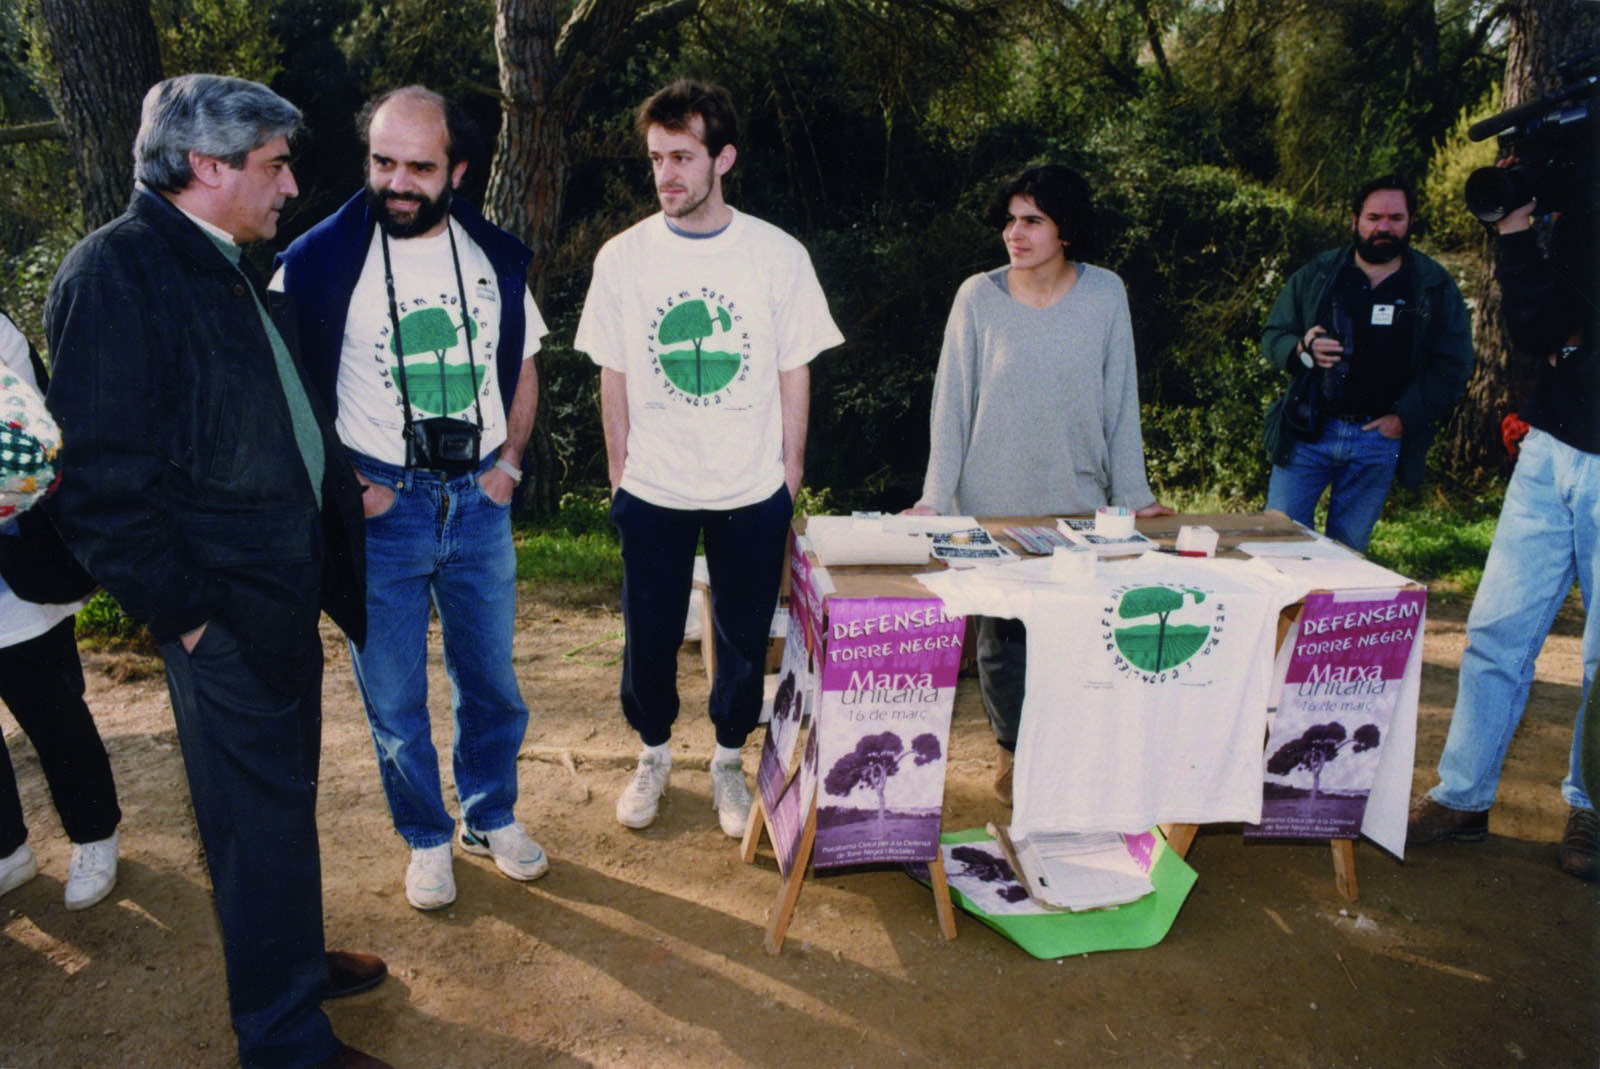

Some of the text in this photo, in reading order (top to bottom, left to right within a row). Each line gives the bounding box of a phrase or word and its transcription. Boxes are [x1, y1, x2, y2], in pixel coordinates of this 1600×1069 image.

[374, 297, 428, 390] DEFENEM
[1303, 601, 1419, 637] DEFENSEM
[829, 633, 962, 663] TORRE NEGRA
[1296, 628, 1414, 657] TORRE NEGRA
[848, 669, 934, 691] Marxa
[1306, 663, 1384, 684] Marxa
[850, 710, 865, 722] 16
[869, 708, 889, 721] de
[1319, 700, 1338, 712] de
